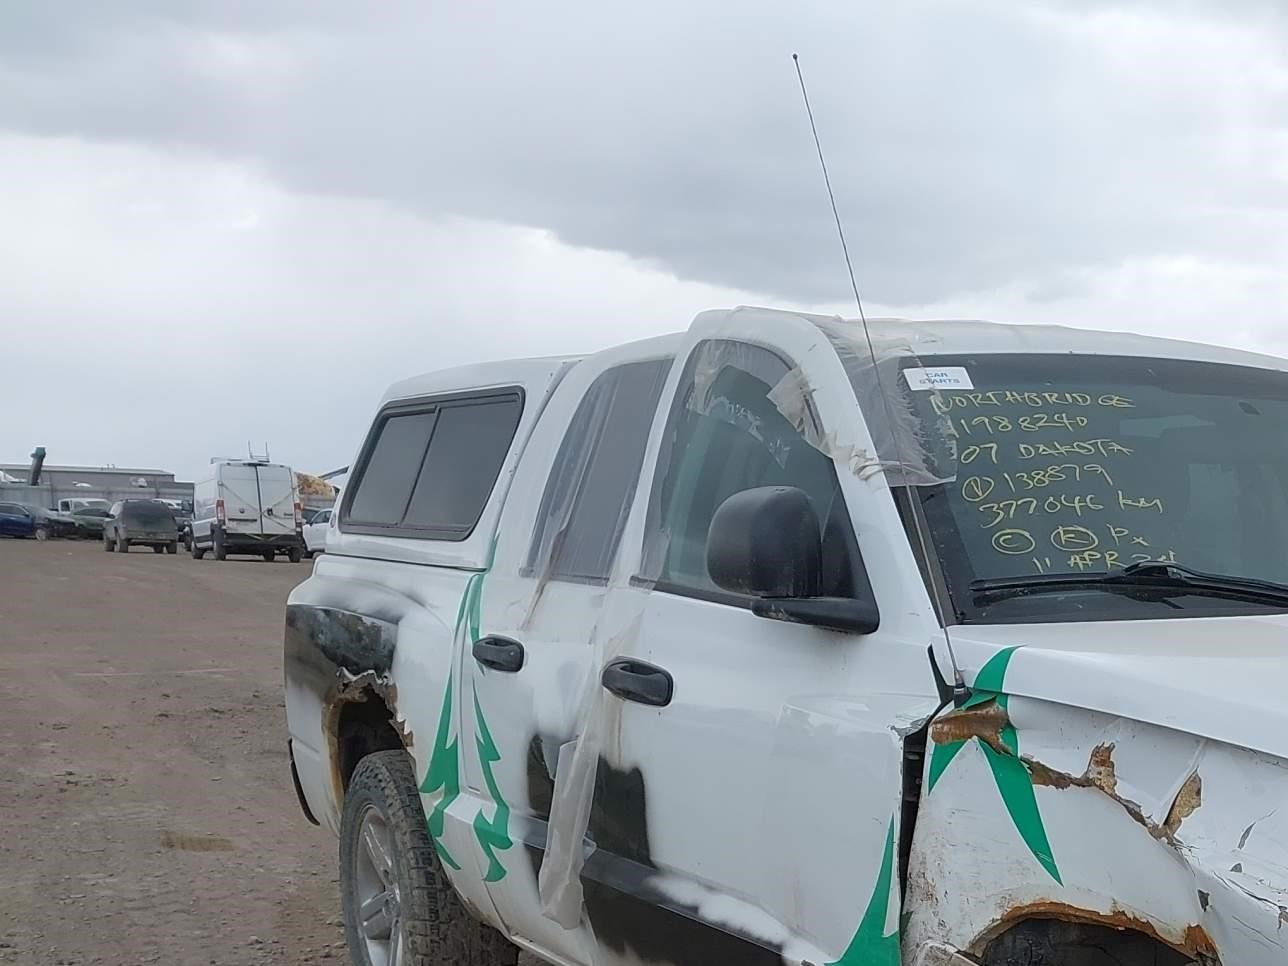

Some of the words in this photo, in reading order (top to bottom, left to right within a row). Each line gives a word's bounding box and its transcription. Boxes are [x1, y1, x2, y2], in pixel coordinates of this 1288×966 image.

[960, 443, 998, 465] 07
[1018, 439, 1134, 460] DAKOTA
[1003, 464, 1113, 493] 138879
[978, 494, 1104, 529] 377046
